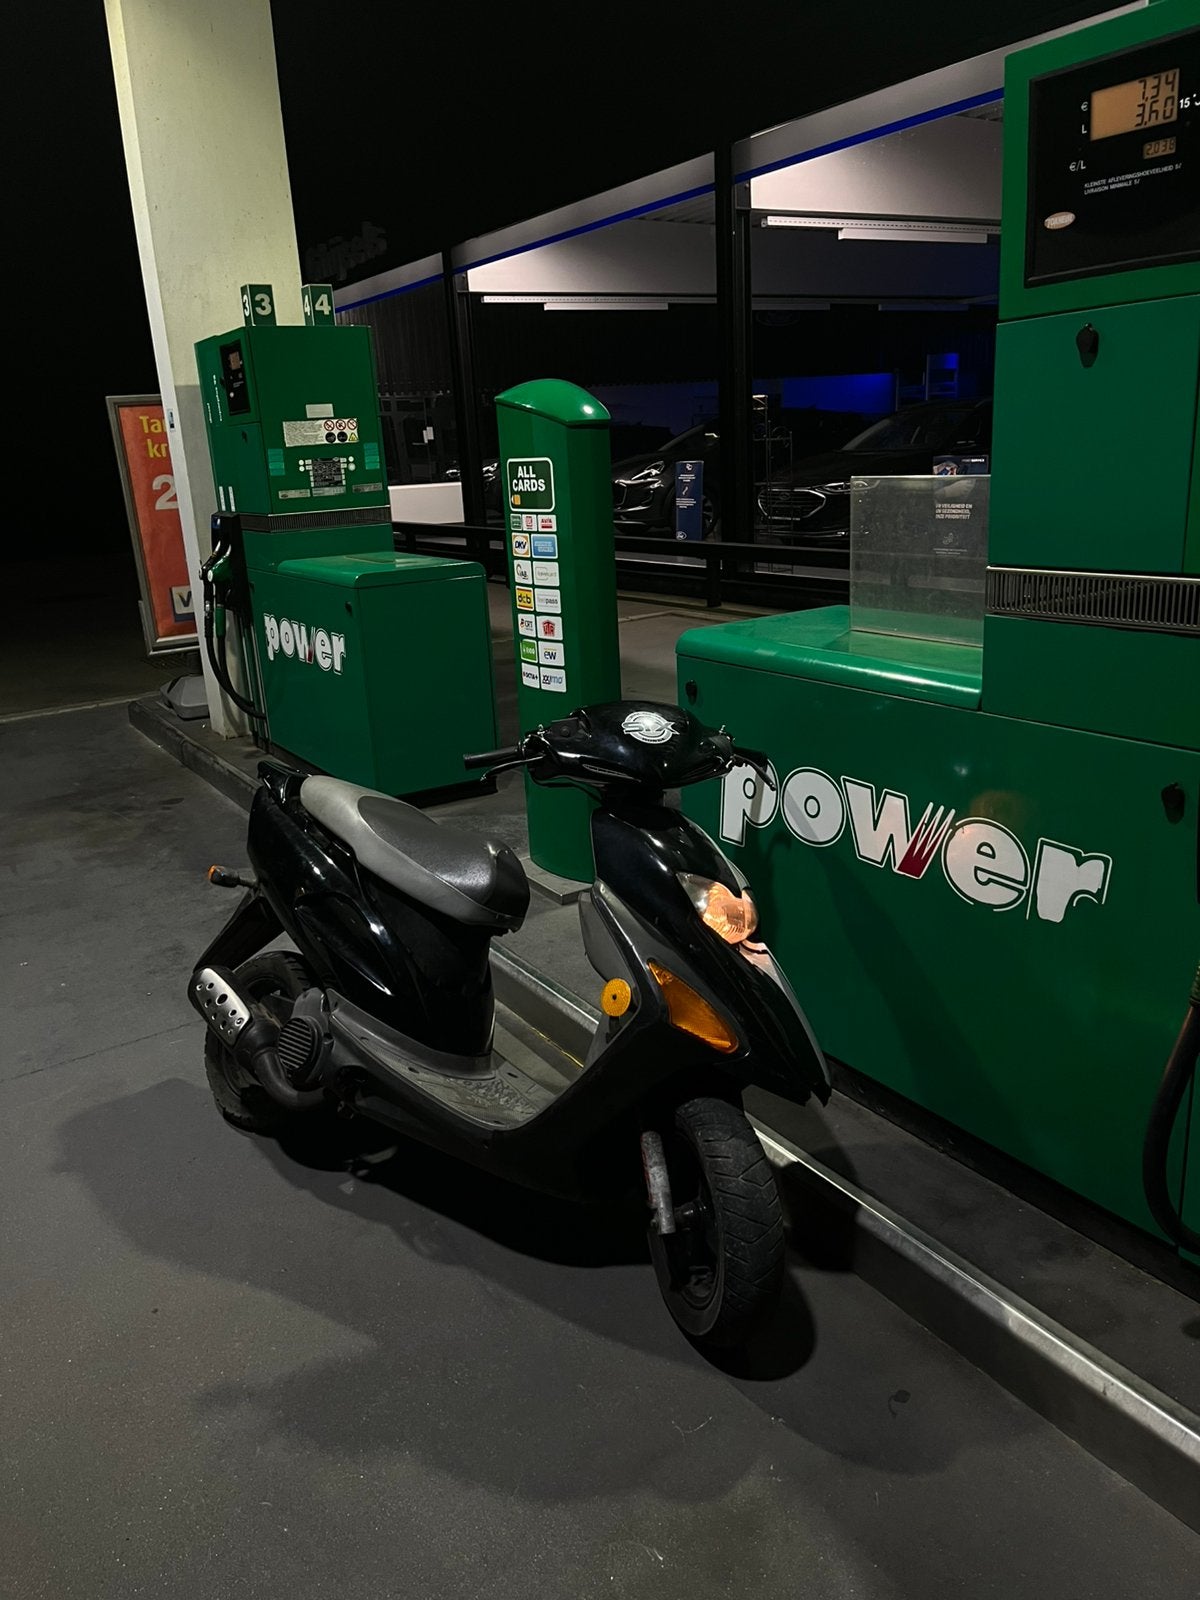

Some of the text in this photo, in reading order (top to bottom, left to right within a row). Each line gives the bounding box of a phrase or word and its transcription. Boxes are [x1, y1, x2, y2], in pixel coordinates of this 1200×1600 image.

[1081, 124, 1088, 134] L
[1069, 160, 1086, 171] €/L
[242, 294, 250, 317] 3
[255, 293, 272, 316] 3
[304, 294, 311, 316] 4
[315, 293, 332, 315] 4
[518, 465, 536, 478] ALL
[512, 479, 546, 491] CARDS
[515, 541, 527, 550] DKV
[263, 612, 347, 676] power
[719, 757, 1113, 924] power
